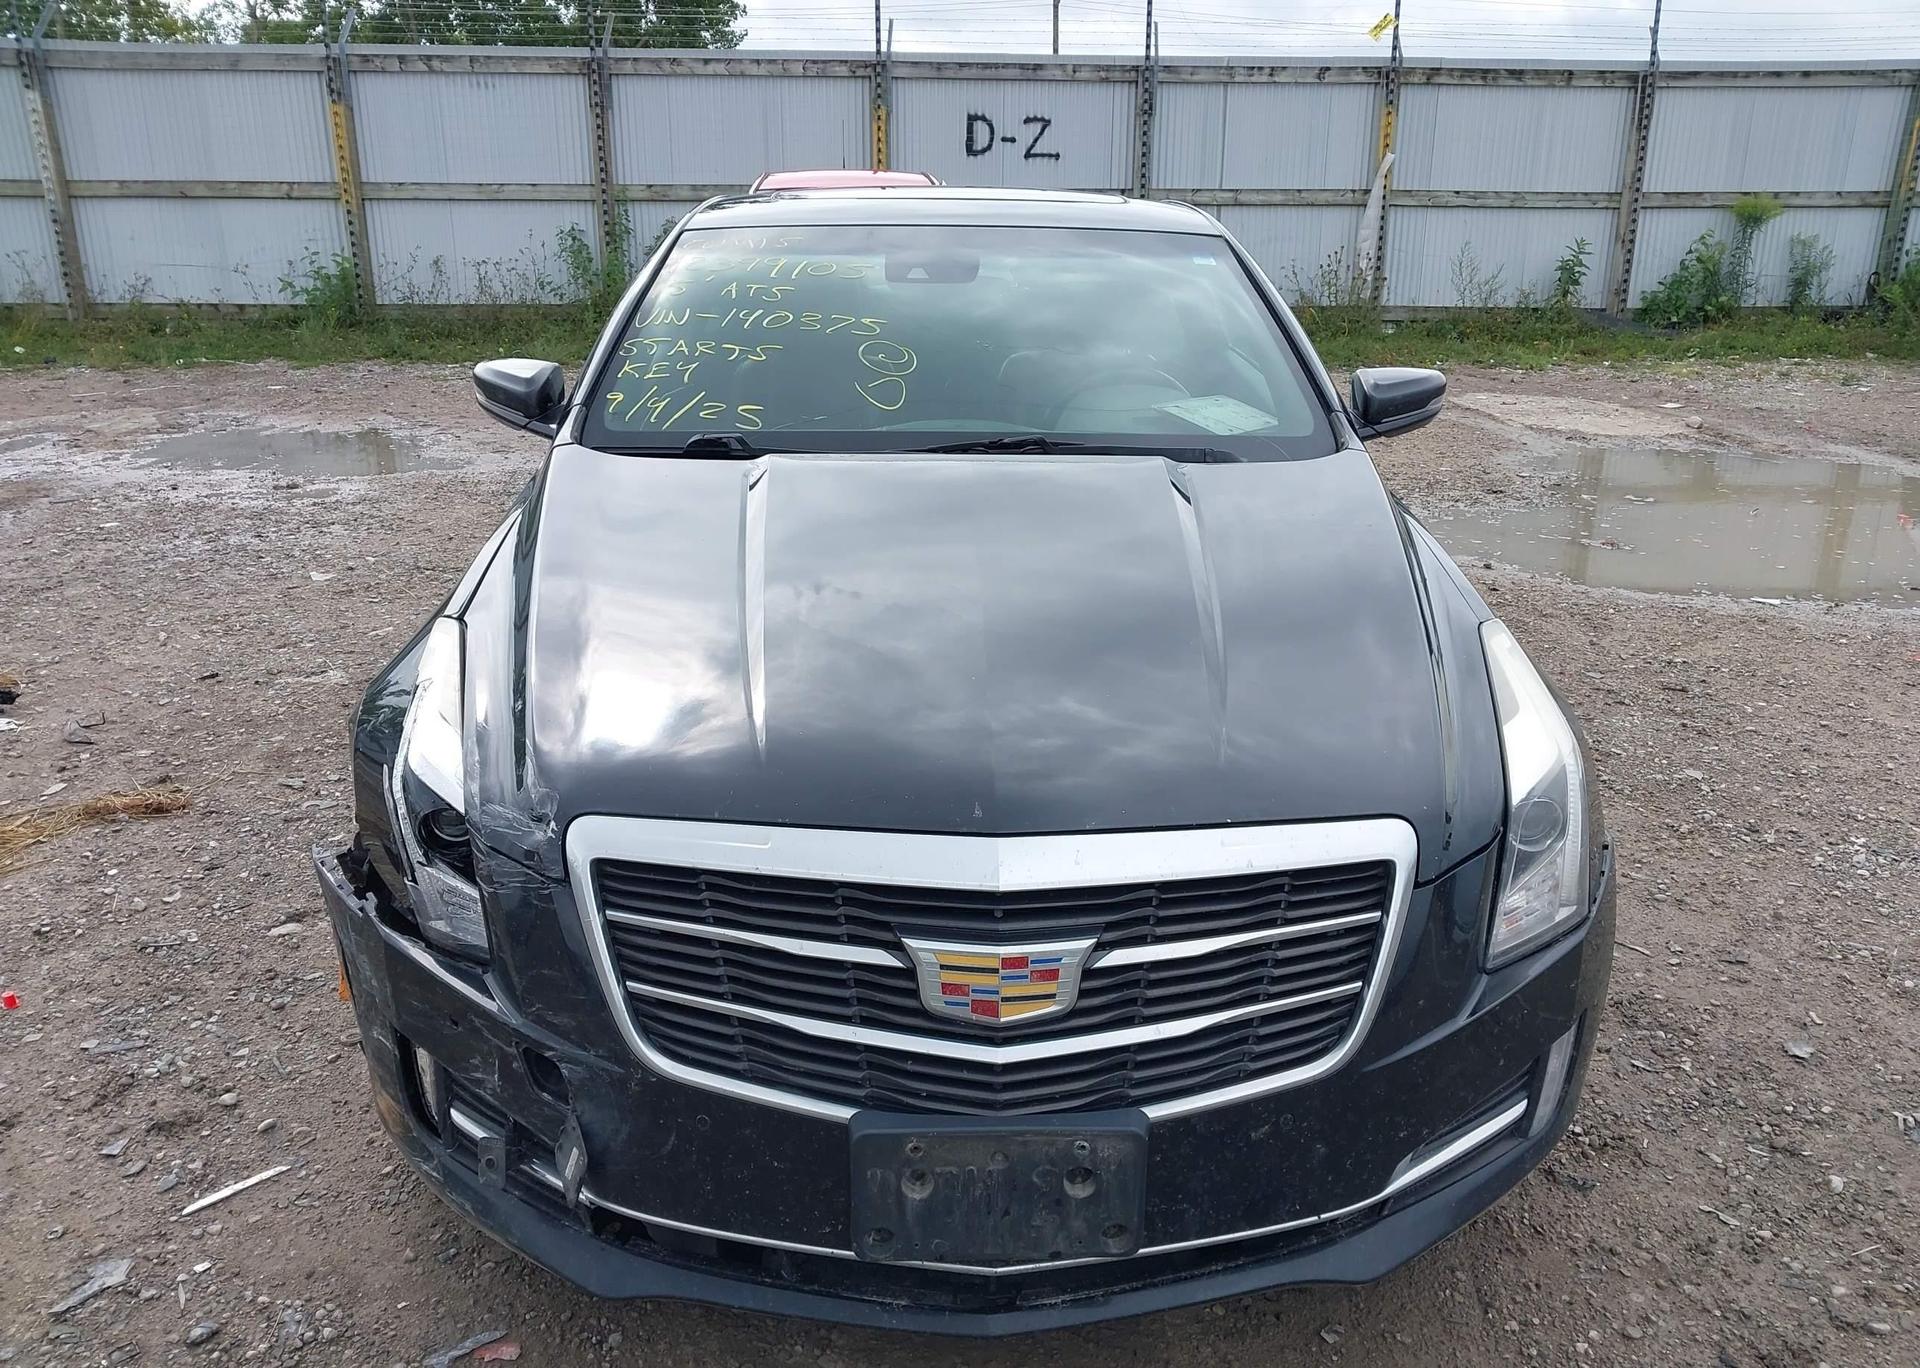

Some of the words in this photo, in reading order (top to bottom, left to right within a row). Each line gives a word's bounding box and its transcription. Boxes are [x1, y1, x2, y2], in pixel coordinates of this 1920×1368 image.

[965, 112, 1061, 161] D-Z
[720, 281, 796, 302] ATS
[619, 337, 784, 361] STARTS
[617, 360, 700, 384] KEY
[606, 385, 765, 430] 9/4/25
